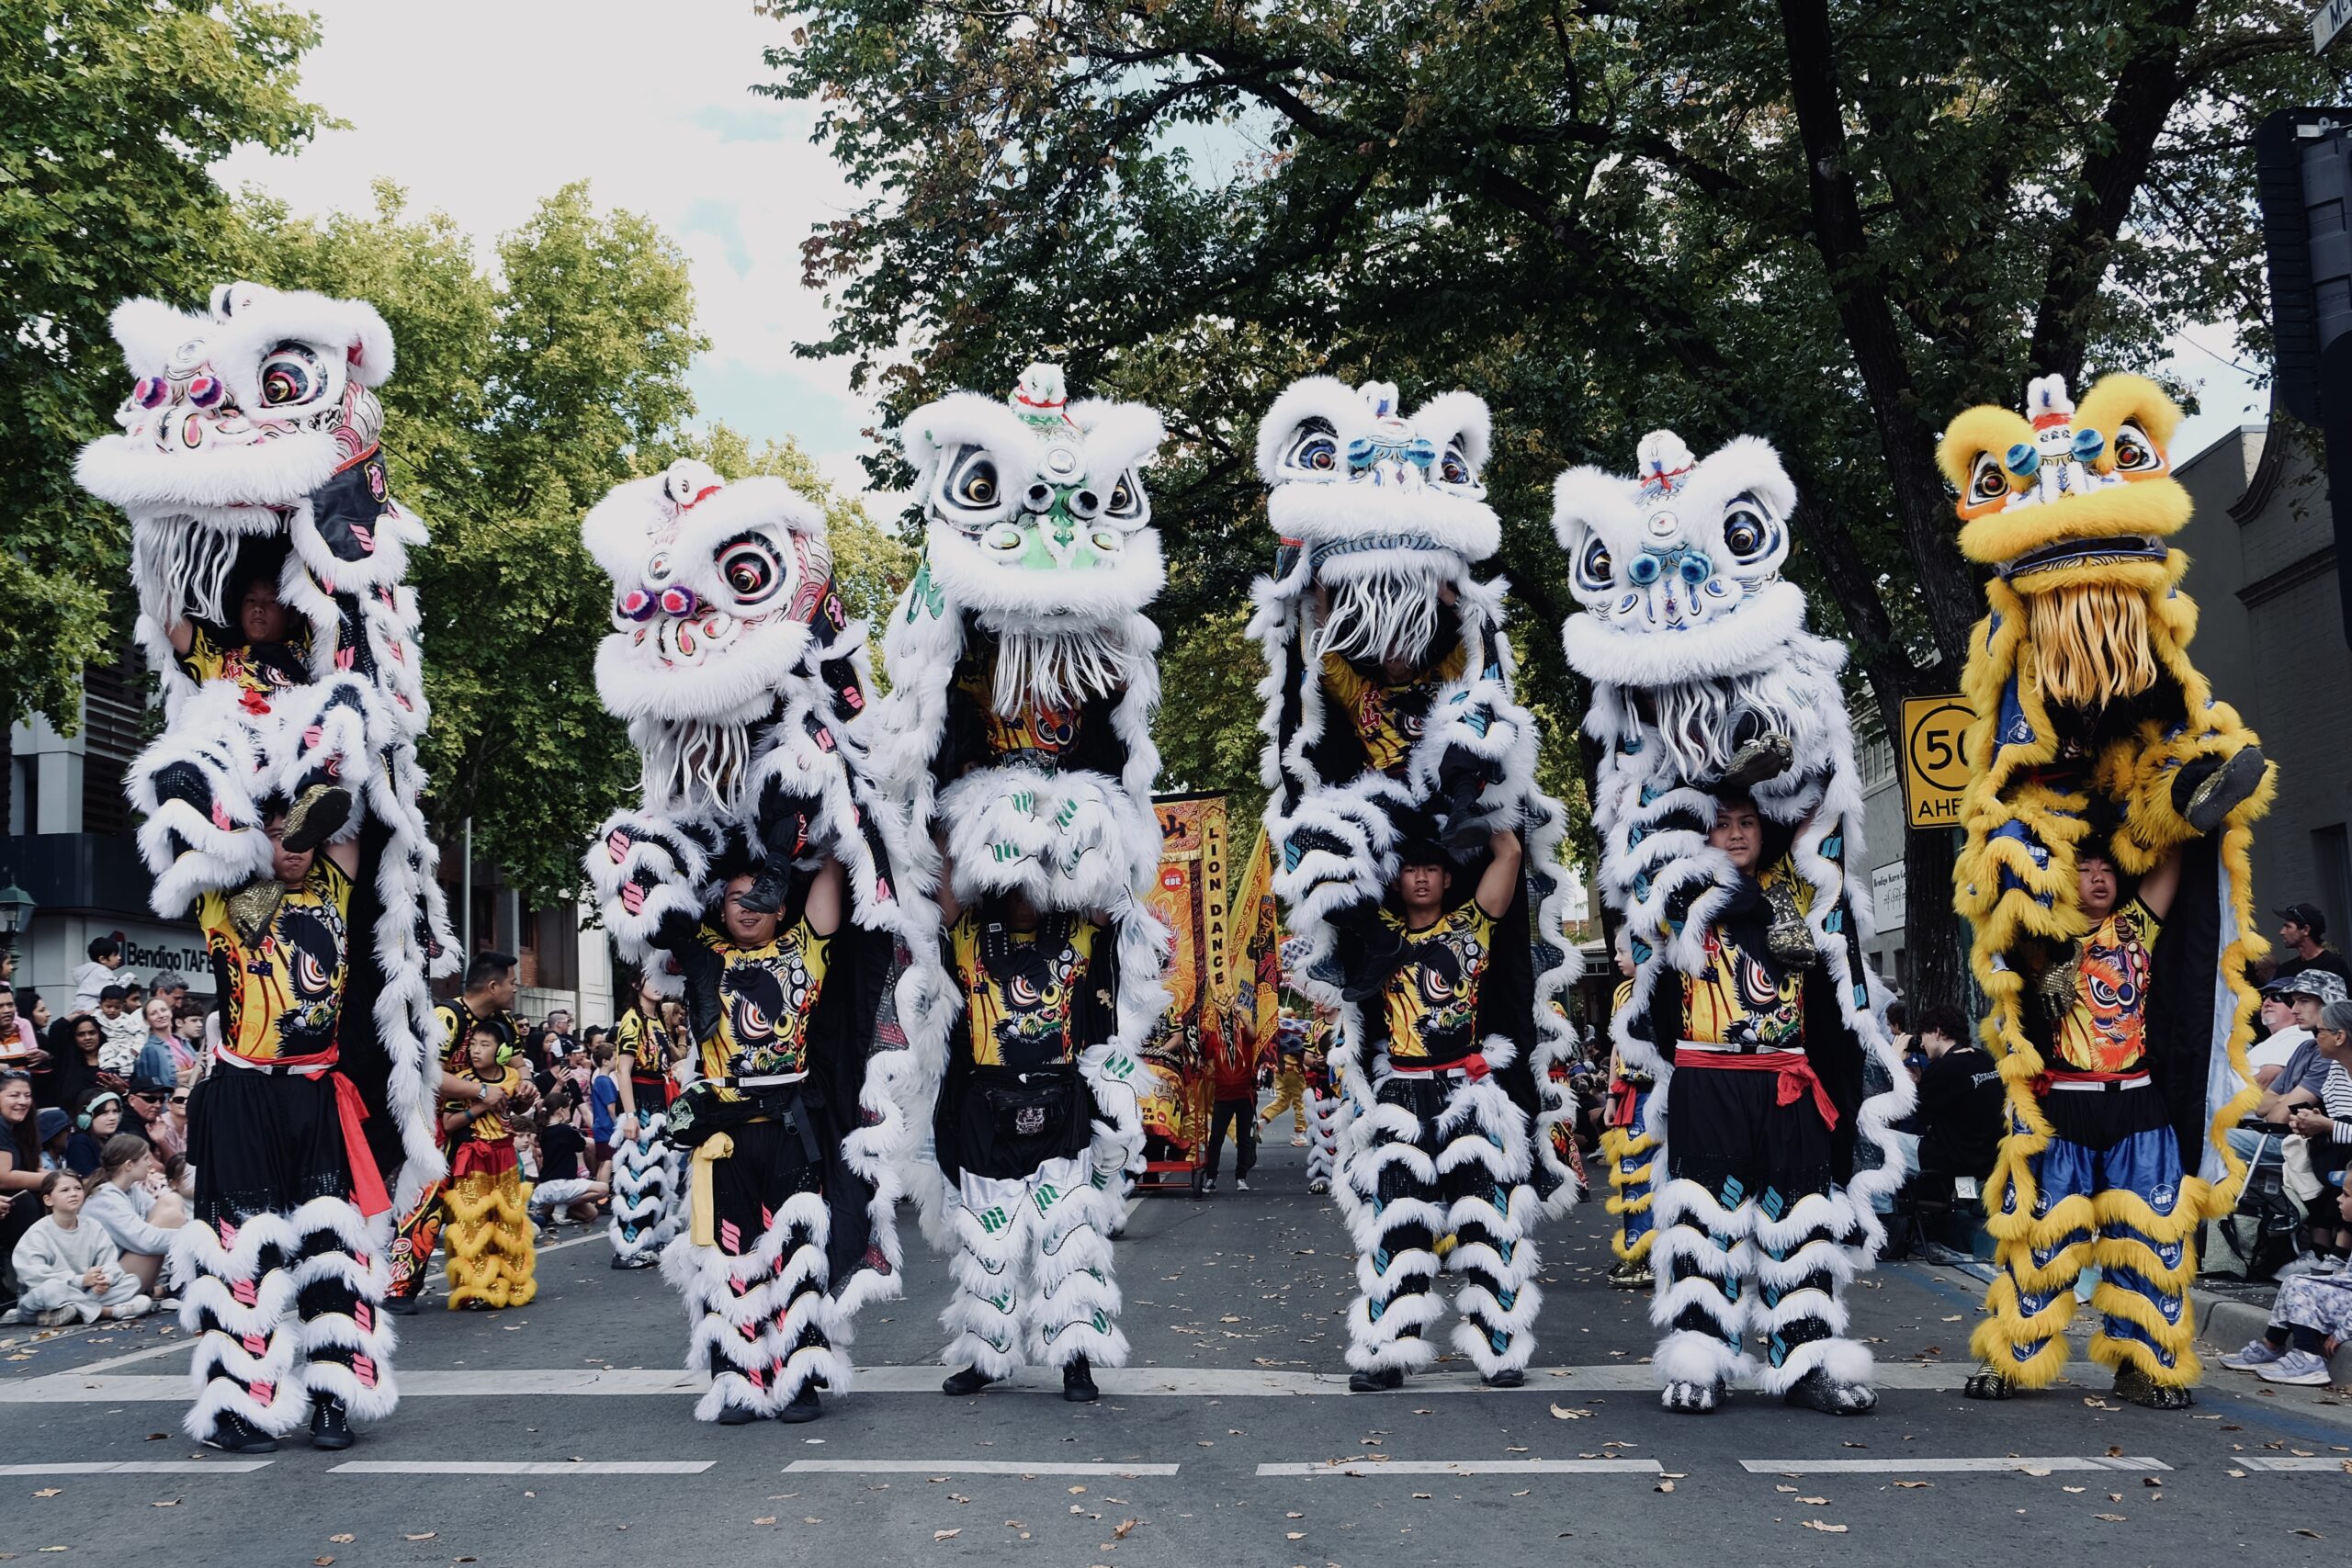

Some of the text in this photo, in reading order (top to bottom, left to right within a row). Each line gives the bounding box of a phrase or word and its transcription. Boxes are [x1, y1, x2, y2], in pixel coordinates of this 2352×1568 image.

[1918, 797, 1963, 818] AHE
[1208, 827, 1225, 987] LION DANCE
[127, 942, 182, 972] Bendigo
